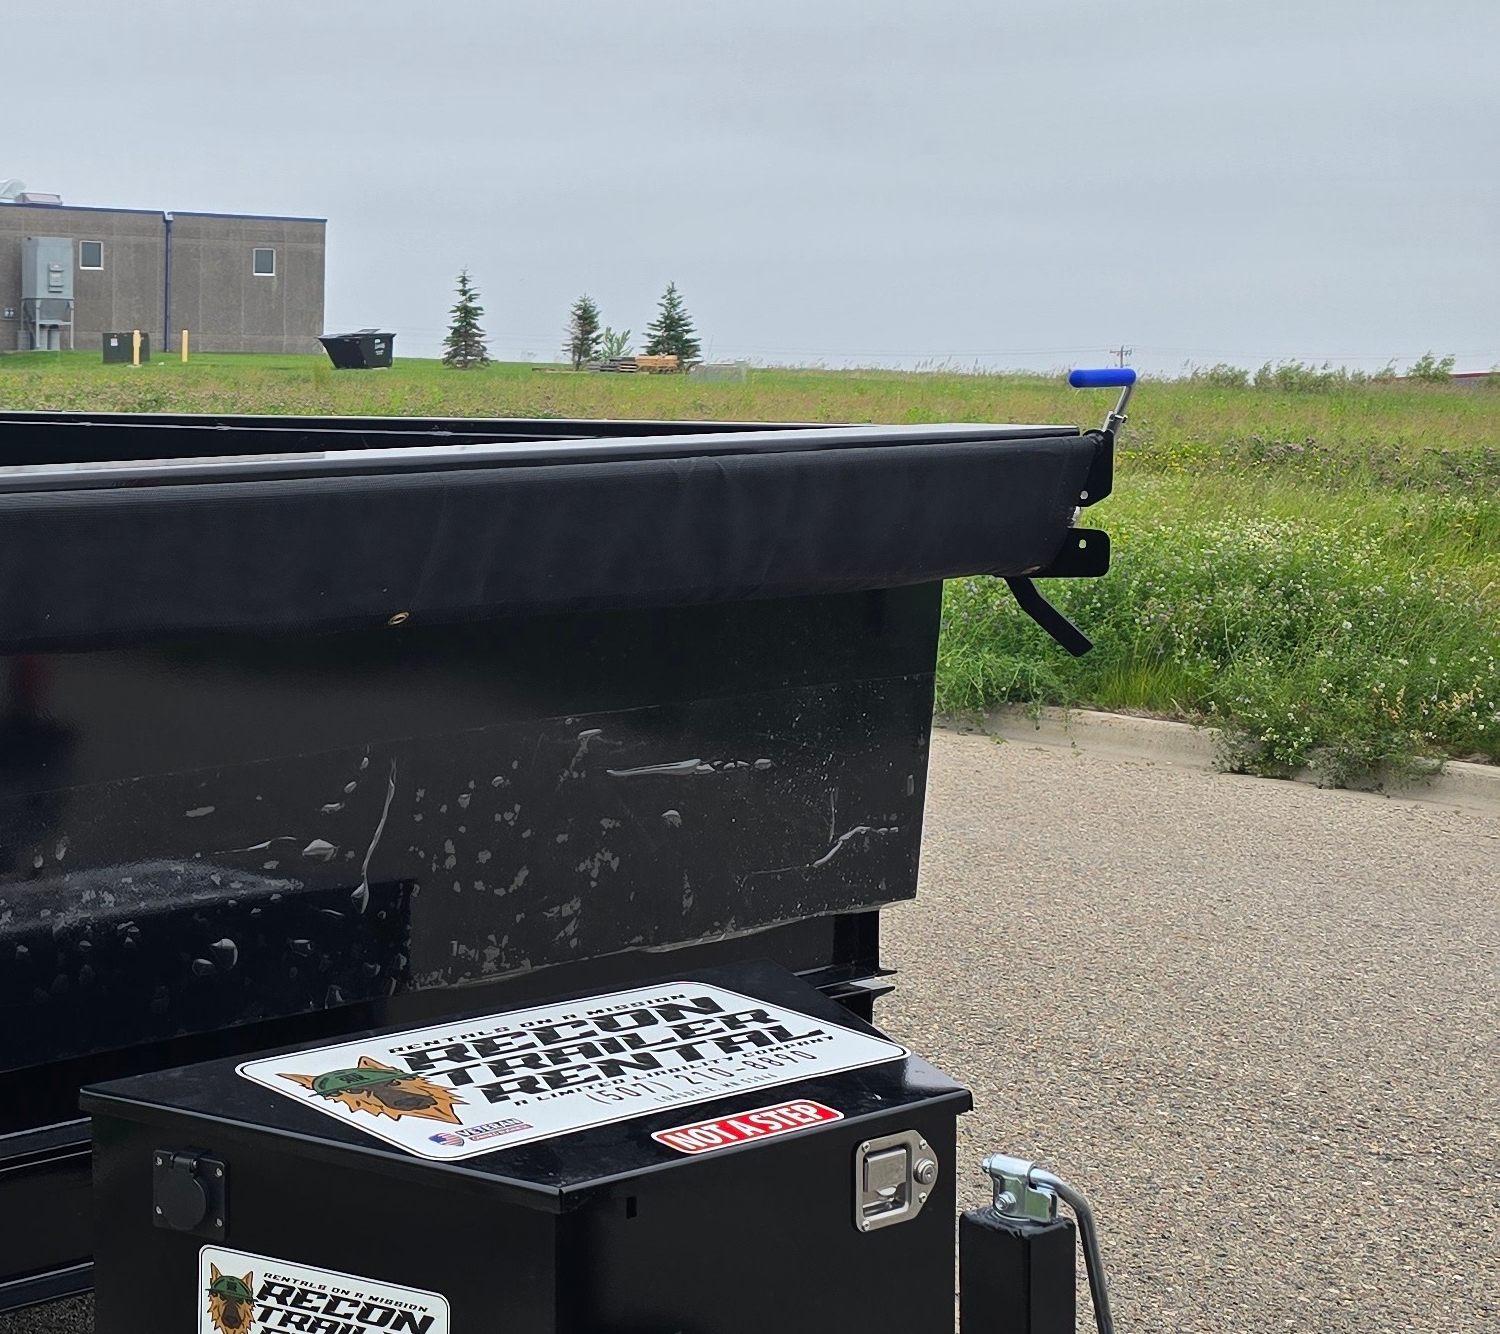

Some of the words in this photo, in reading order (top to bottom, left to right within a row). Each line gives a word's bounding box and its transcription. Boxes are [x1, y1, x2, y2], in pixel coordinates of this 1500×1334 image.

[388, 1026, 510, 1054] RENTALS
[519, 1017, 553, 1028] ON
[585, 993, 687, 1016] MISSION
[397, 996, 726, 1072] RECON
[425, 1008, 781, 1087] TRAILER
[474, 1024, 826, 1105] RENTAL
[513, 1099, 529, 1107] A
[536, 1078, 625, 1102] LIMITED
[632, 1056, 734, 1081] LIABILITY
[741, 1035, 834, 1058] COMPANY
[586, 1079, 675, 1106] (507)
[673, 1049, 818, 1086] 210-8890
[456, 1117, 524, 1138] VETERAN
[663, 1123, 739, 1150] NOT
[727, 1119, 766, 1136] A
[748, 1104, 823, 1131] STEP
[263, 1272, 327, 1290] RENTALS
[331, 1287, 351, 1296] ON
[368, 1295, 428, 1312] MISSION
